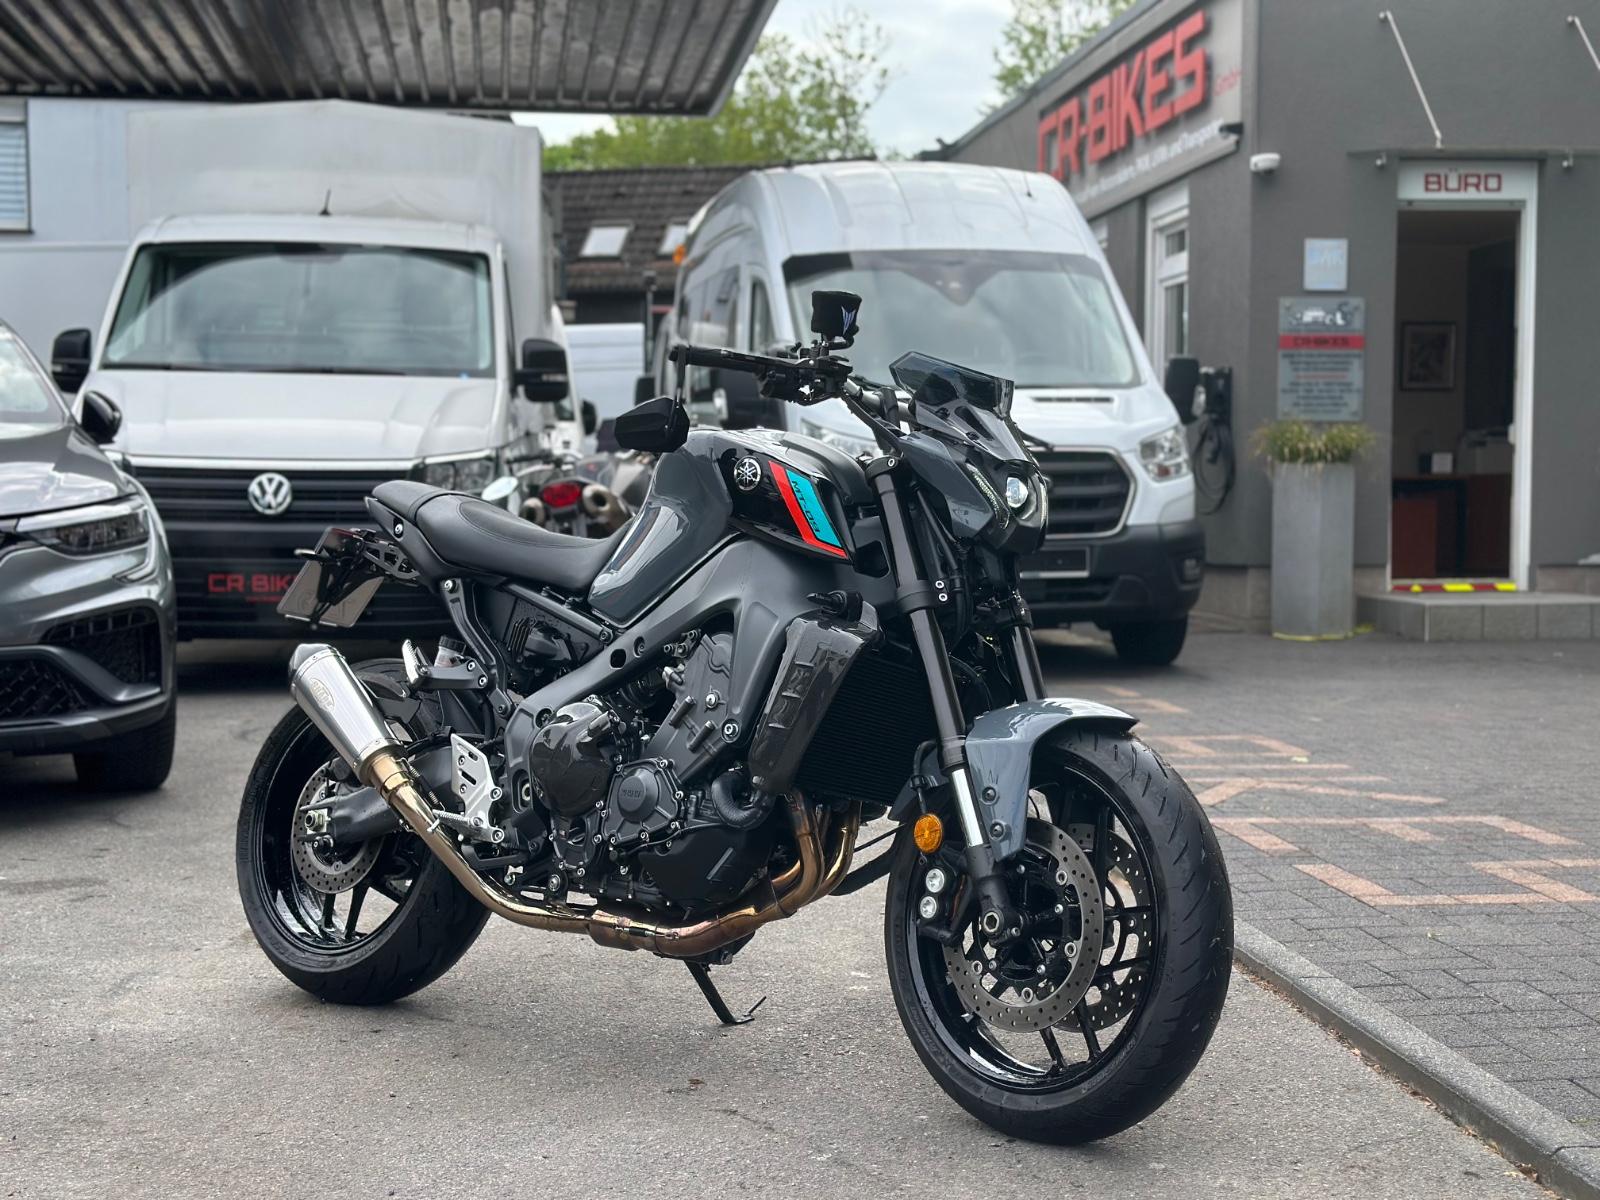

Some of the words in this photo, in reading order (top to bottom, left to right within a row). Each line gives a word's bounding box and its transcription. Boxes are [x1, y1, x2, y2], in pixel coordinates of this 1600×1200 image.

[1037, 9, 1206, 181] CR-BIKES
[1423, 167, 1502, 193] BÜRO
[251, 573, 301, 593] BIK
